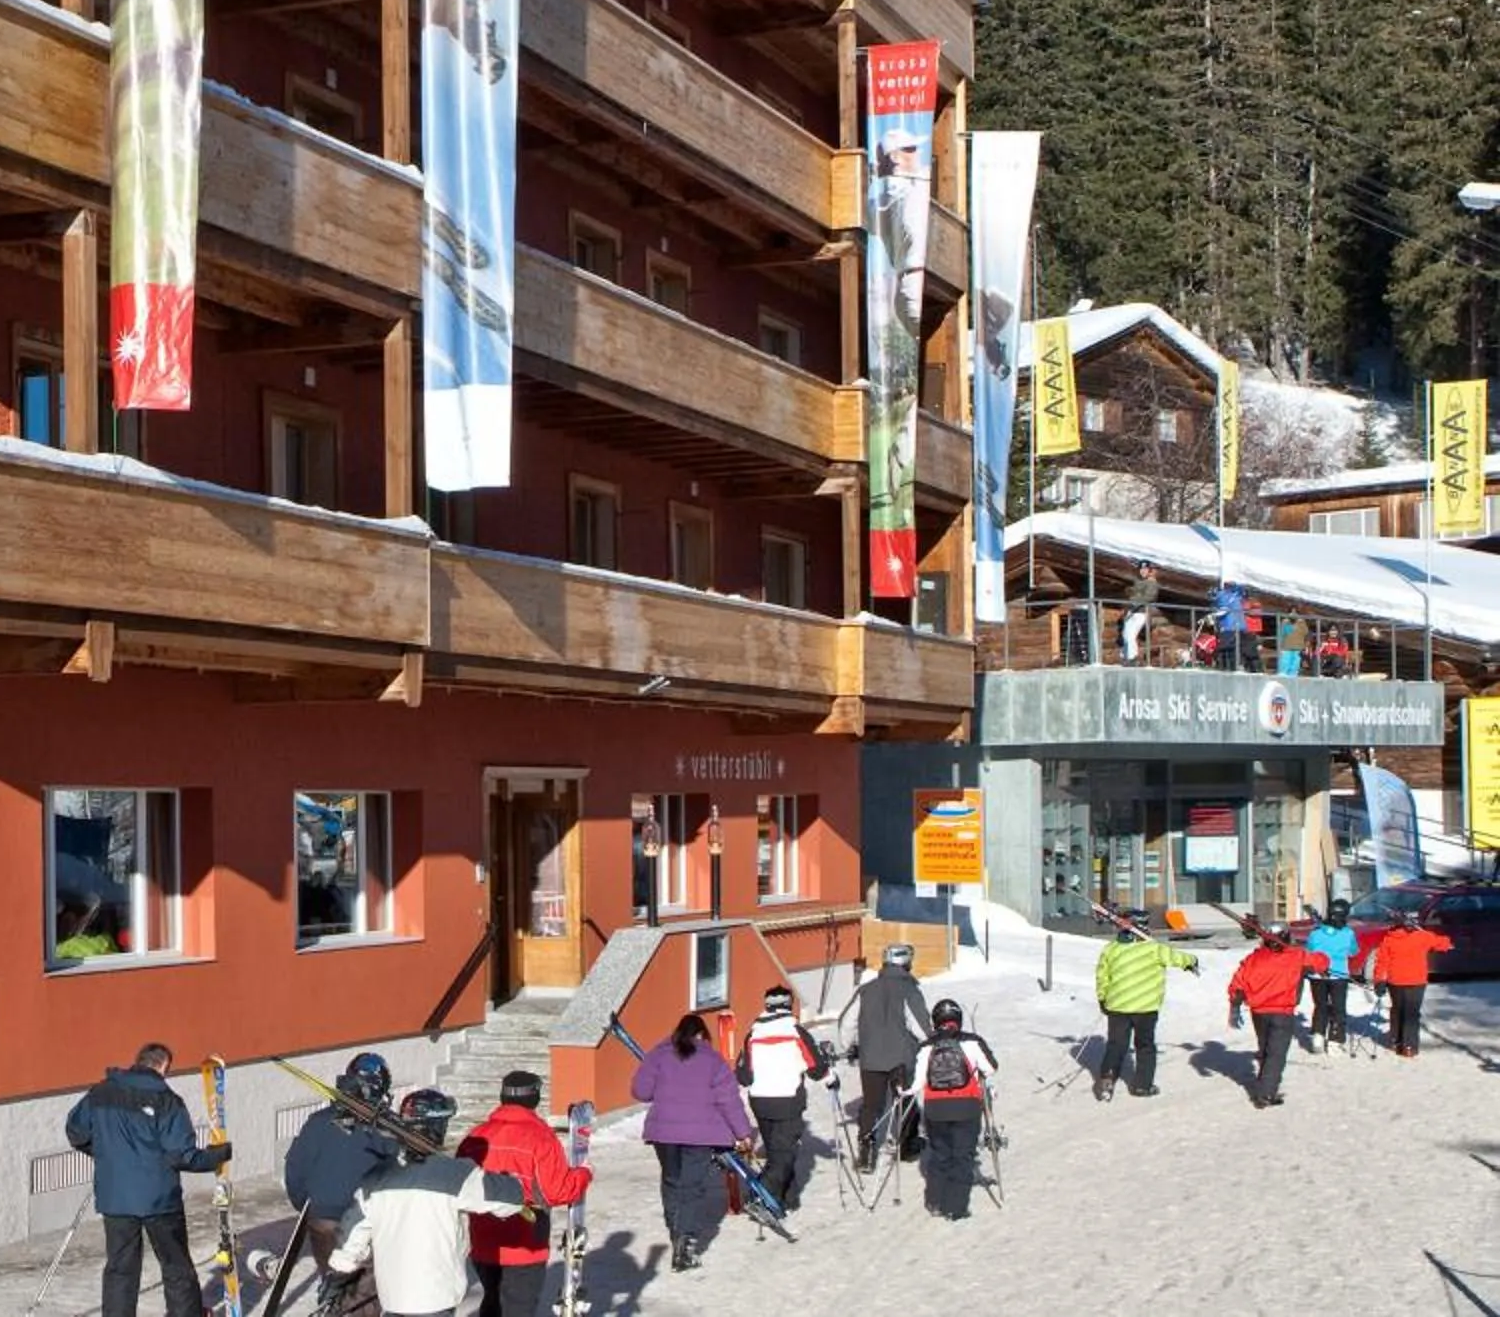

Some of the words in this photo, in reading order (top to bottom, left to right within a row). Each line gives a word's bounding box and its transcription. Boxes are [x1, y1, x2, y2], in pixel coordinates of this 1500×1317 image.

[1118, 692, 1161, 721] Arosa
[1167, 693, 1191, 721] Ski
[1197, 694, 1248, 722] Service
[1299, 698, 1319, 724] Ski
